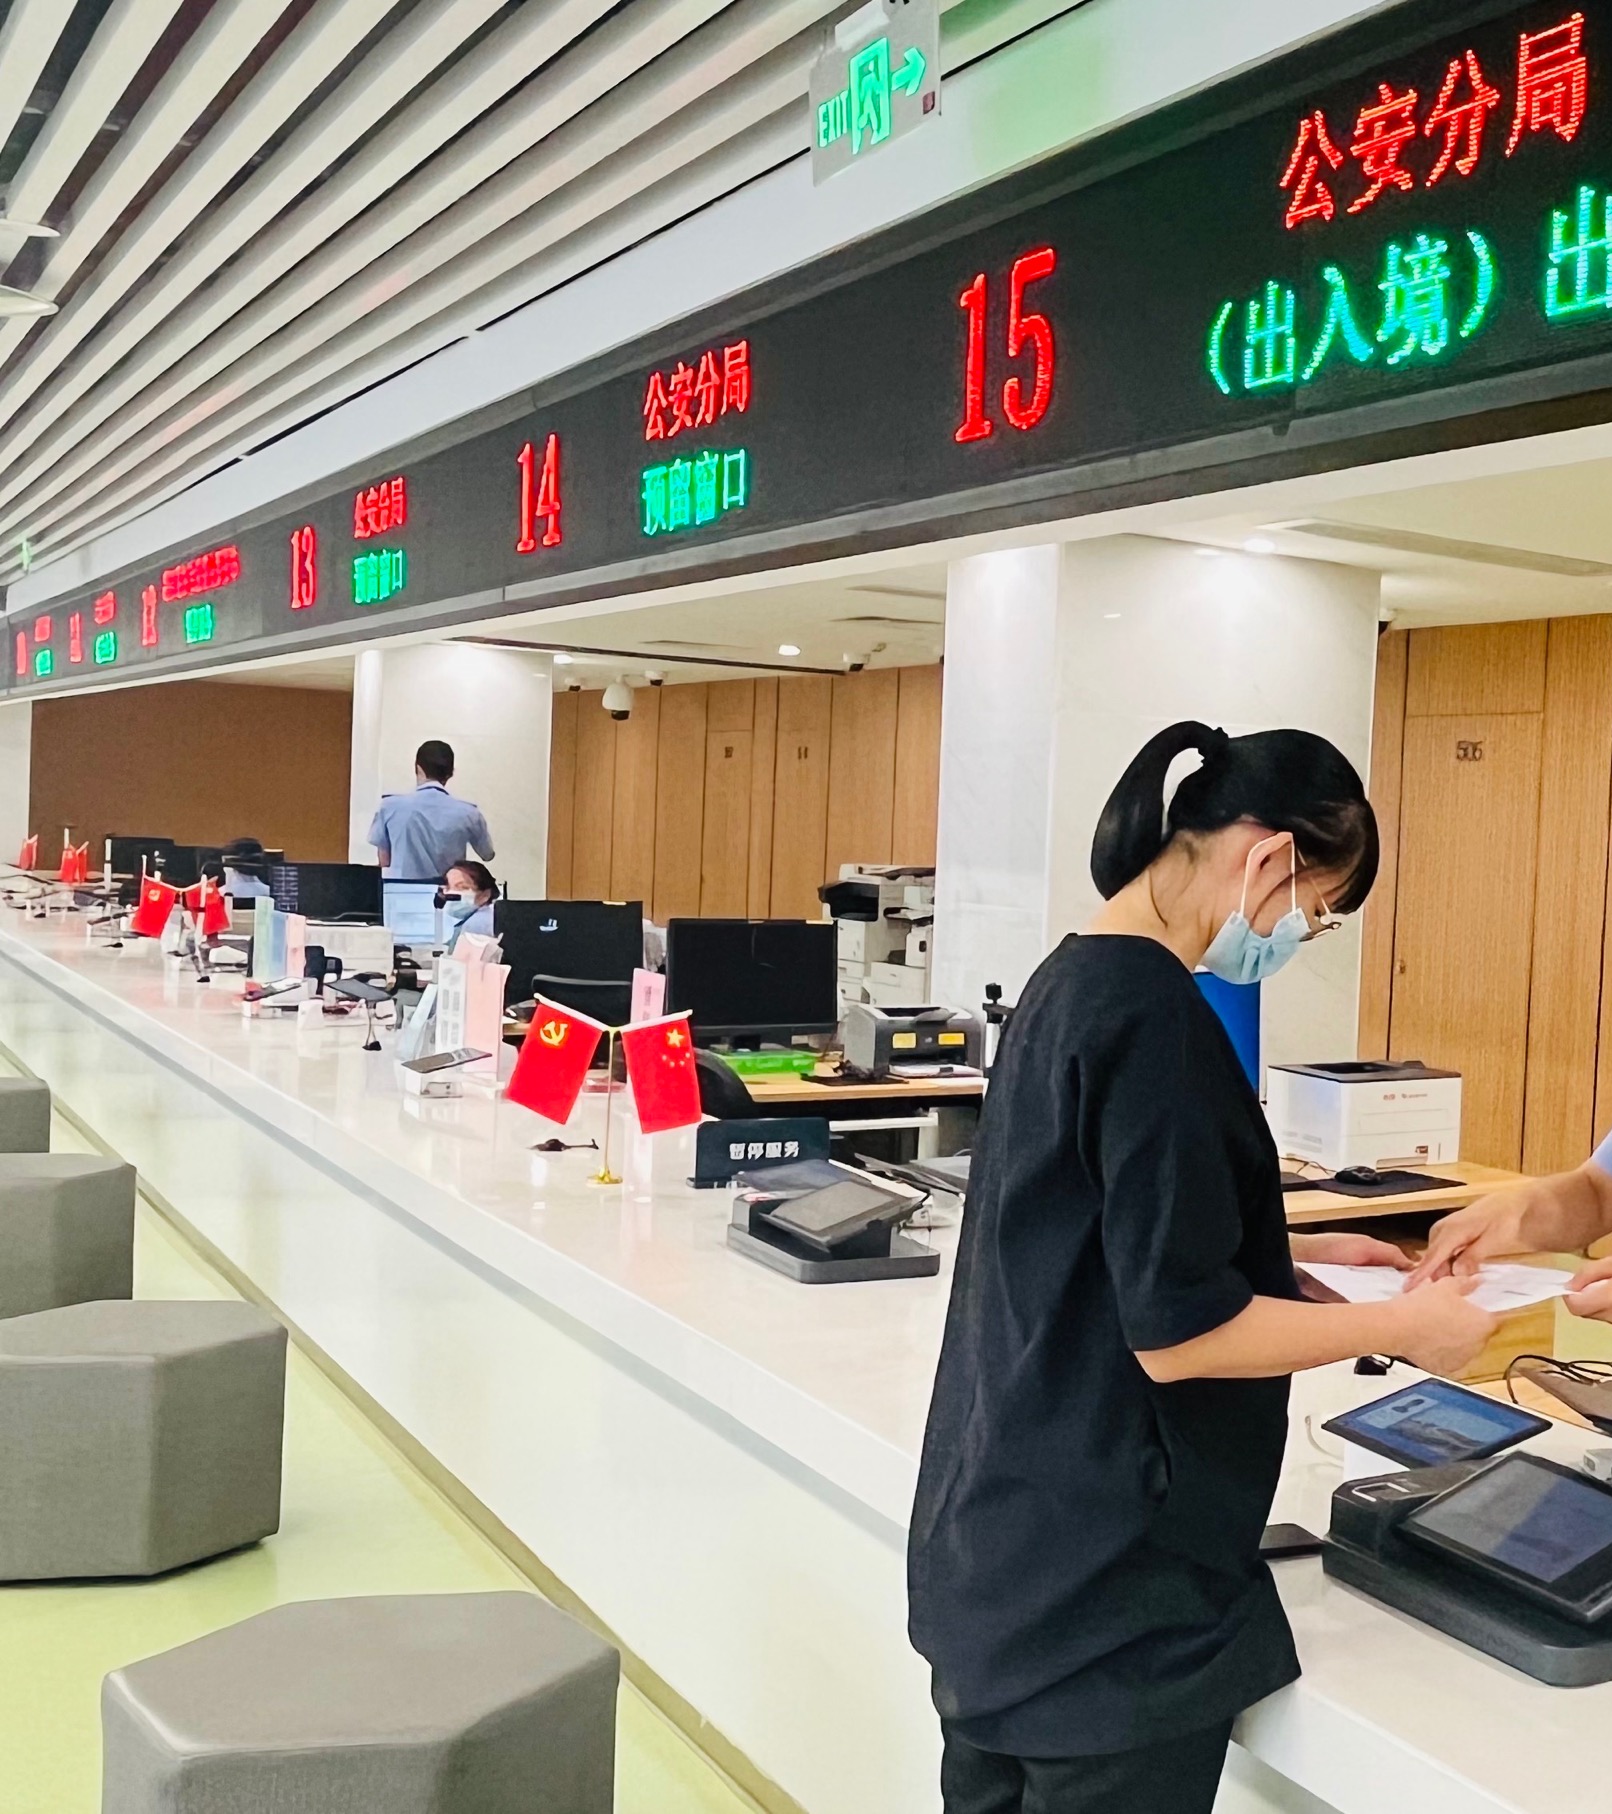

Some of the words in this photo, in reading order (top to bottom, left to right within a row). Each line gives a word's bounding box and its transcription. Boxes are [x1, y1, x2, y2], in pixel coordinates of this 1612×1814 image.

[1281, 13, 1586, 229] 公安分局
[643, 340, 748, 440] 公安分局
[956, 248, 1055, 441] 15
[517, 433, 561, 553] 14
[642, 448, 747, 536] 预留窗口
[291, 526, 317, 608] 13
